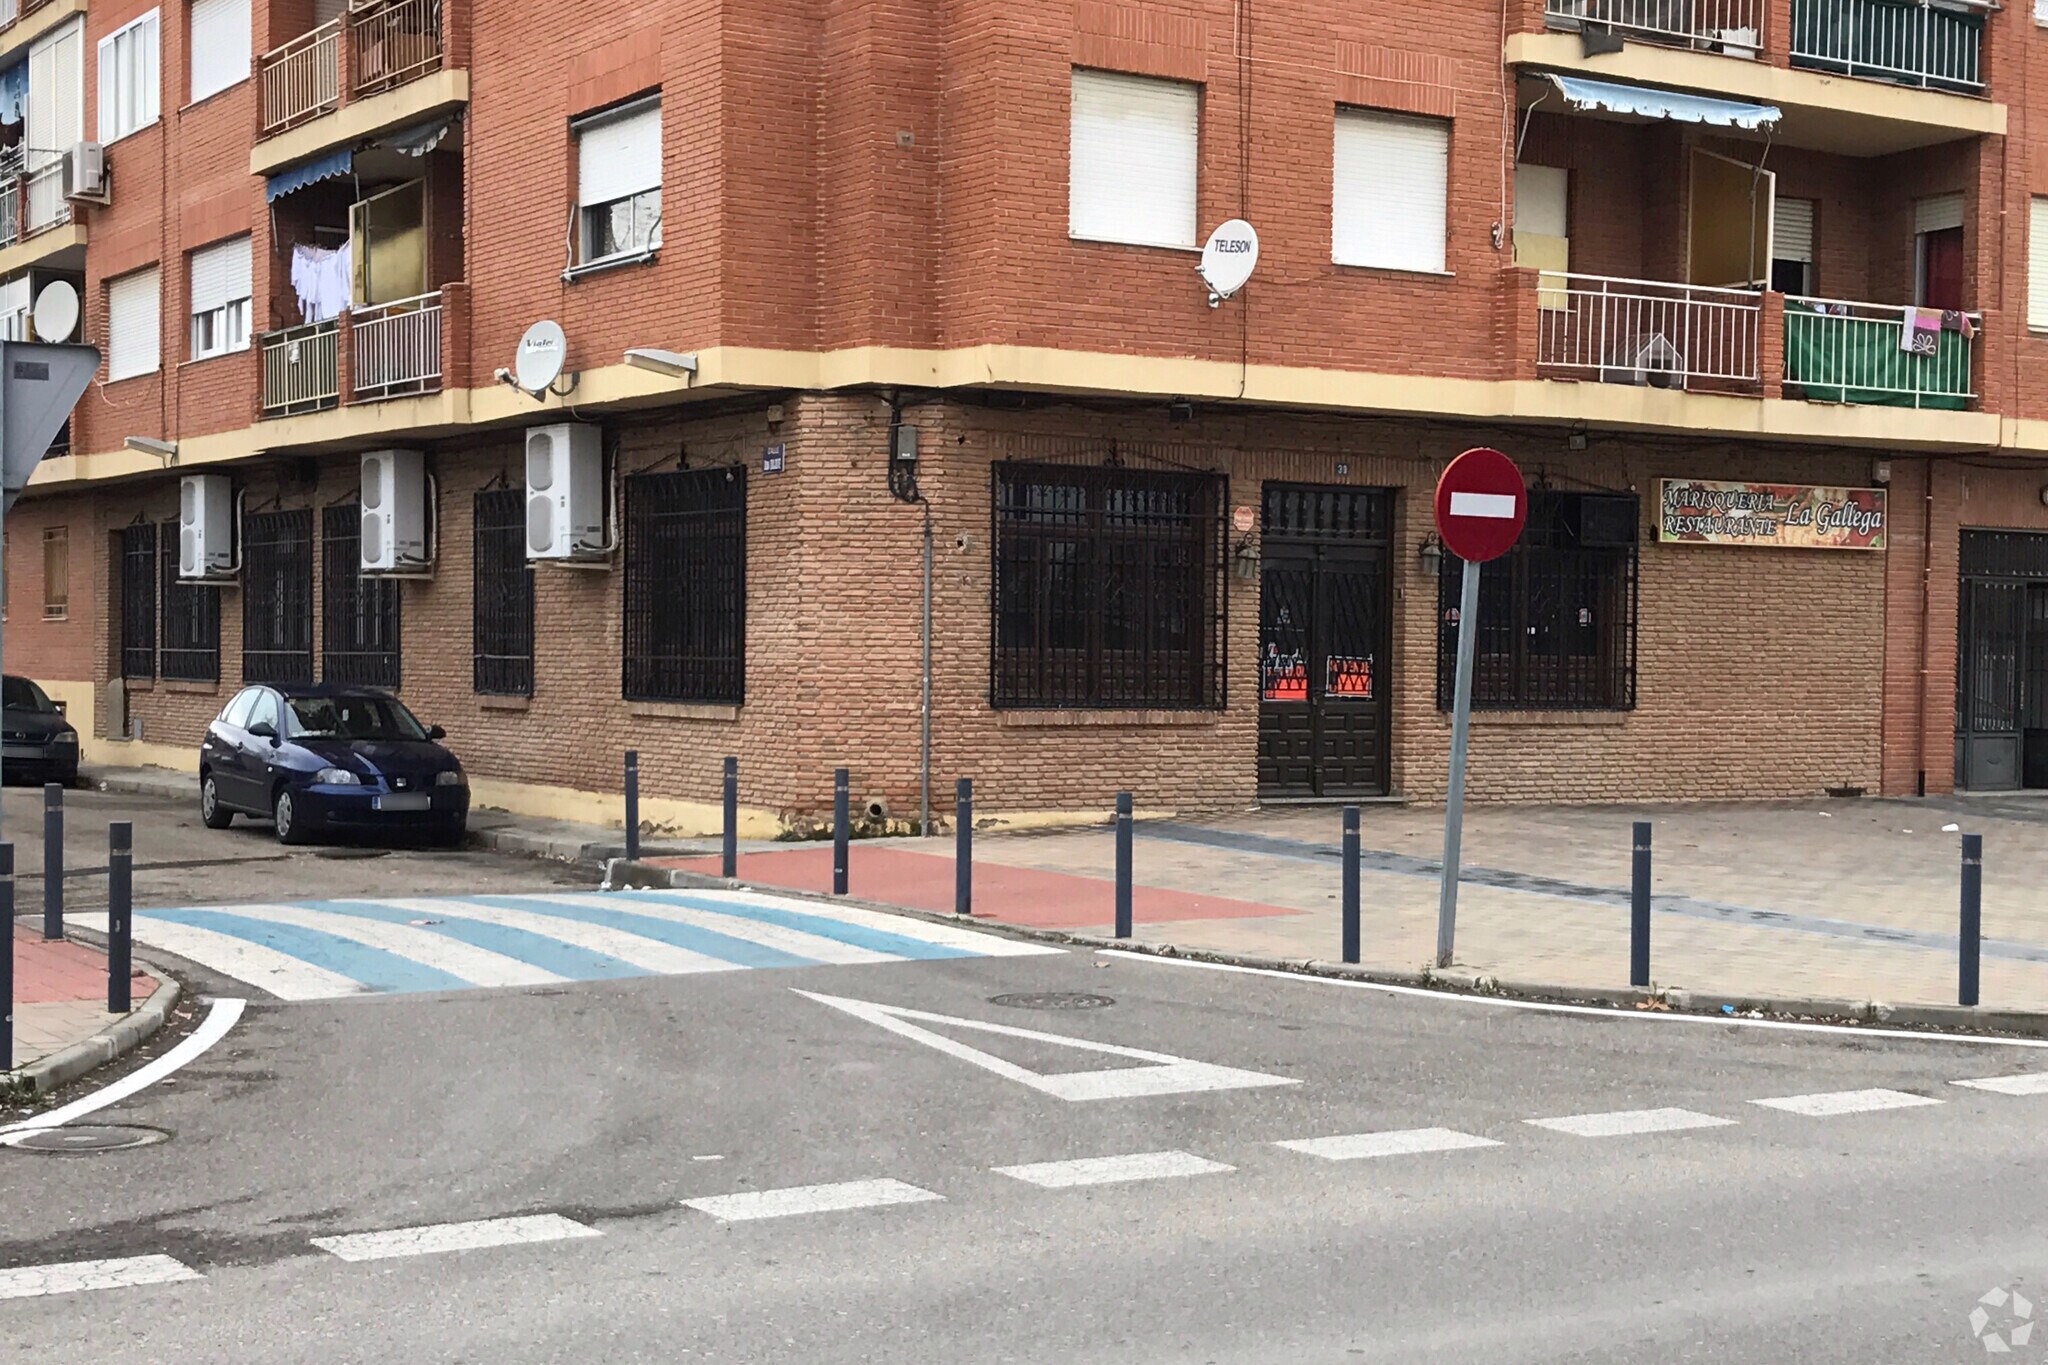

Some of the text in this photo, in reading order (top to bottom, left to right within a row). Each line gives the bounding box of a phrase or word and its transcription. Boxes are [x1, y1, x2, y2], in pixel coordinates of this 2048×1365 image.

[1214, 239, 1252, 254] TELESON
[1663, 488, 1774, 514] MARISQUERIA
[1663, 515, 1777, 538] RESTAURANTE
[1785, 501, 1882, 536] La Gallega
